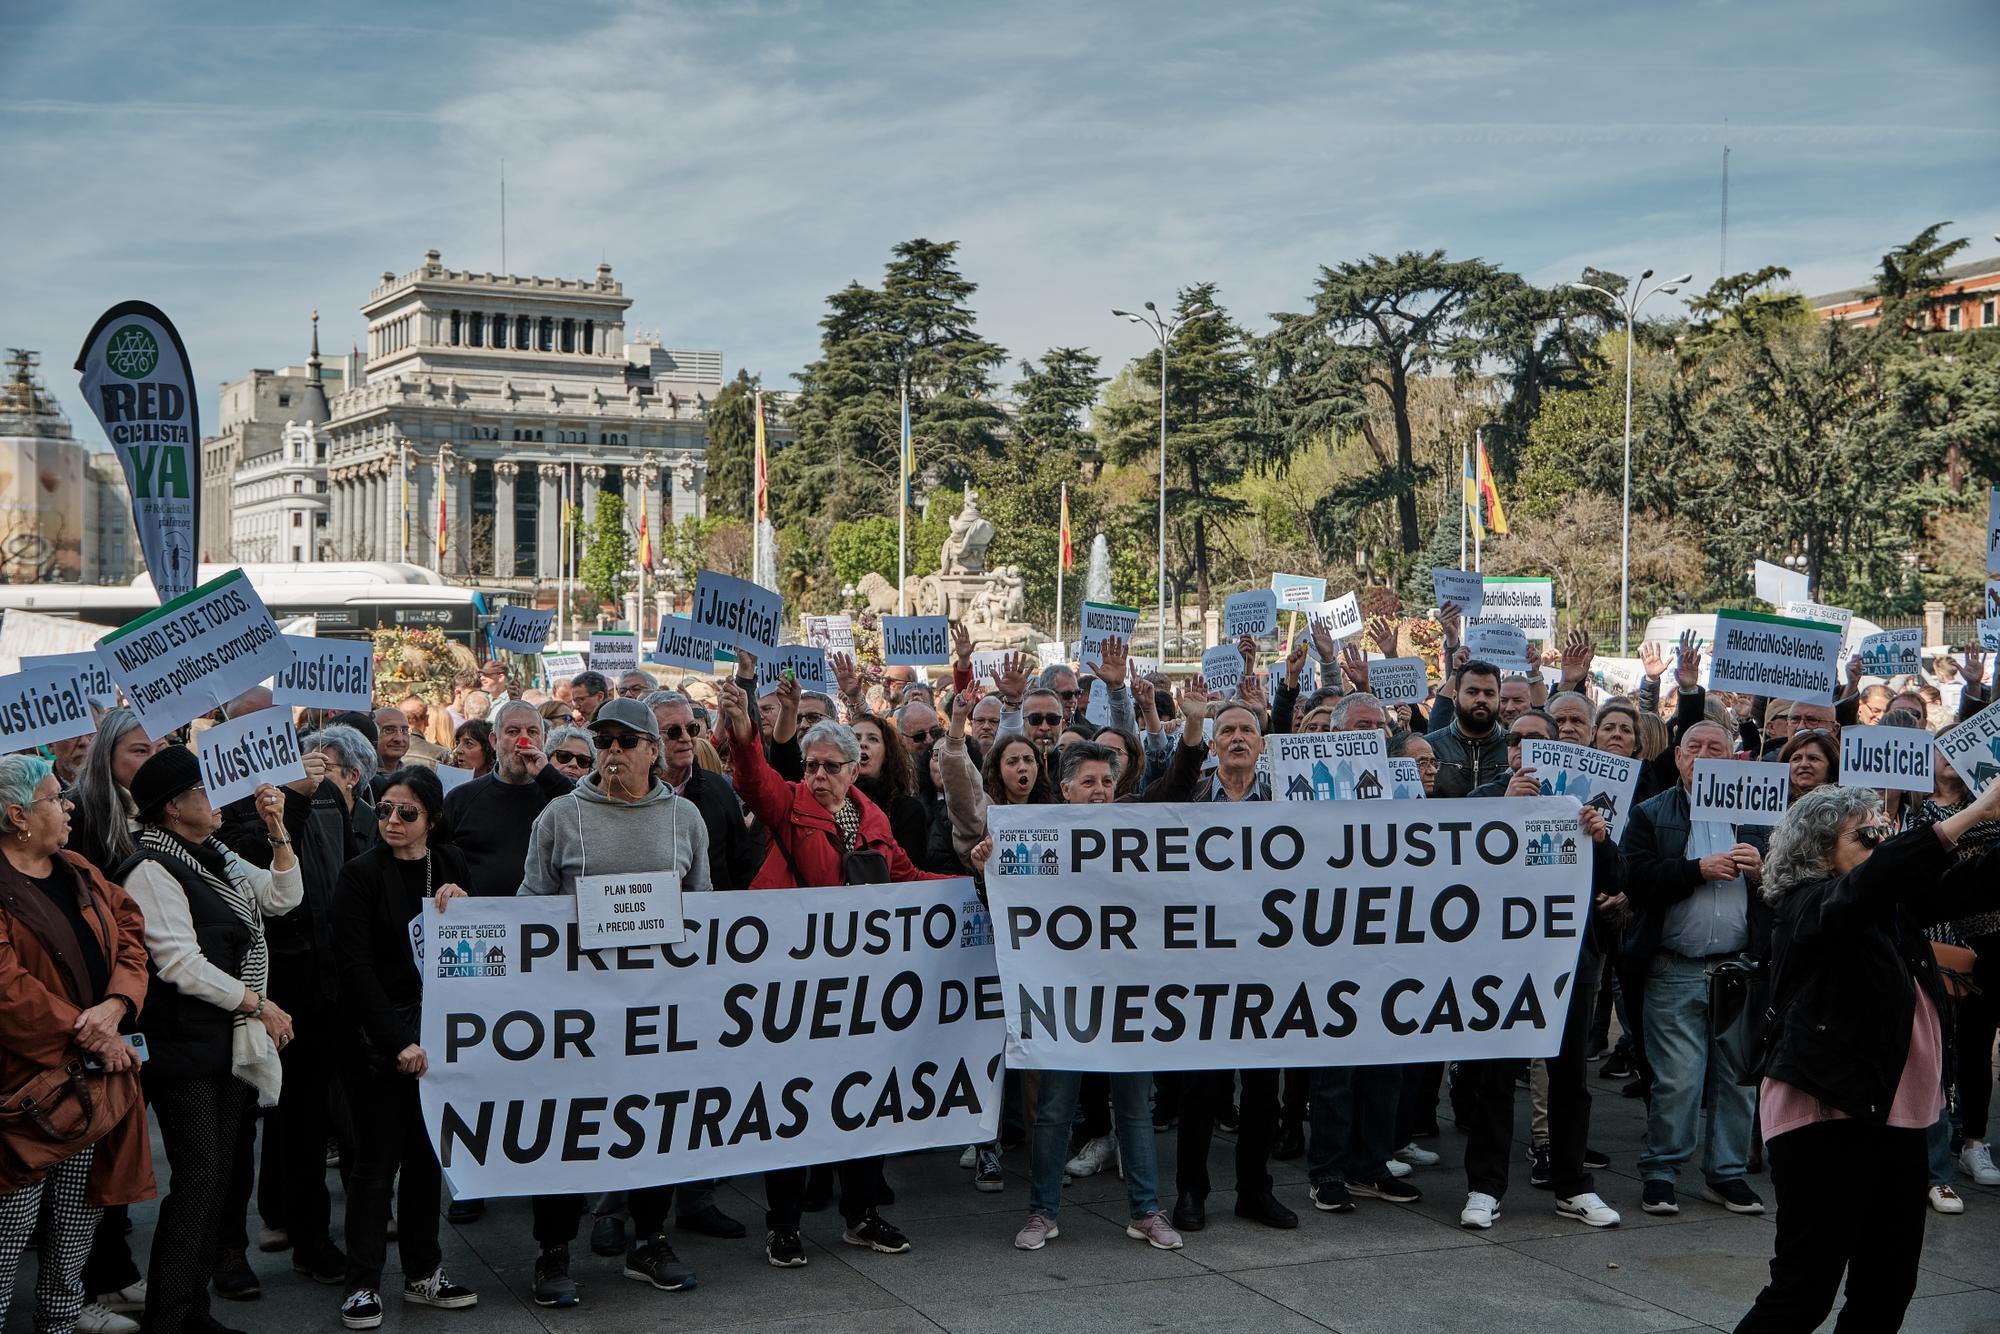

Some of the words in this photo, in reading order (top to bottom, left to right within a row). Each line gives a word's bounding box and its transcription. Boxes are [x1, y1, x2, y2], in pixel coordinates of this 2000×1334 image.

[100, 382, 185, 423] RED
[127, 445, 190, 499] YA
[697, 587, 778, 648] ¡Justicia!
[1231, 620, 1265, 636] 18000
[1808, 608, 1819, 617] EL
[1821, 610, 1848, 622] SUELO
[114, 630, 168, 673] MADRID
[162, 621, 187, 648] ES
[179, 611, 206, 638] DE
[197, 590, 251, 629] TODOS.
[659, 627, 713, 662] ¡Justicia!
[886, 627, 946, 655] ¡Justicia!
[1727, 628, 1826, 661] #MadridNoSeVende.
[1891, 633, 1918, 642] SUELO
[1480, 647, 1515, 656] VIVIENDAS
[130, 674, 173, 716] ¡Fuera
[170, 652, 220, 696] políticos
[217, 615, 277, 665] corruptos!
[1372, 664, 1415, 674] PLATAFORMA
[1715, 658, 1831, 693] #MadridVerdeHabitable.
[1890, 665, 1918, 674] 18.000
[1207, 674, 1238, 690] 18000
[1375, 684, 1417, 700] 18000
[1280, 735, 1325, 746] PLATAFORMA
[1326, 735, 1336, 743] DE
[1337, 732, 1376, 742] AFECTADOS
[1940, 712, 1990, 747] PLATAFORMA
[1944, 731, 1982, 760] POR
[1979, 719, 2000, 738] EL
[203, 721, 298, 791] ¡Justicia!
[1281, 745, 1310, 761] POR
[1313, 744, 1332, 759] EL
[1335, 741, 1379, 757] SUELO
[1532, 742, 1574, 753] PLATAFORMA
[1574, 747, 1585, 757] DE
[1586, 751, 1630, 768] AFECTADOS
[1844, 738, 1930, 777] ¡Justicia!
[1388, 760, 1398, 769] DE
[1532, 750, 1560, 767] POR
[1563, 754, 1573, 769] EL
[1577, 758, 1629, 783] SUELO
[1696, 773, 1785, 812] ¡Justicia!
[999, 834, 1017, 842] POR
[1019, 834, 1030, 842] EL
[1031, 833, 1059, 842] SUELO
[1525, 824, 1542, 832] POR
[1543, 824, 1553, 832] EL
[1554, 823, 1578, 832] SUELO
[1070, 823, 1306, 874] PRECIO
[1326, 820, 1520, 870] JUSTO
[1526, 856, 1549, 865] PLAN
[1552, 855, 1576, 864] 18.000
[999, 866, 1026, 875] PLAN
[1030, 866, 1058, 875] 18.000
[604, 884, 626, 896] PLAN
[628, 883, 653, 894] 18000
[613, 902, 646, 914] SUELOS
[962, 904, 975, 914] POR
[1006, 903, 1138, 952] POR
[1163, 903, 1237, 950] EL
[1256, 883, 1481, 949] SUELO
[1501, 893, 1577, 941] DE
[438, 930, 458, 939] POR
[460, 930, 473, 939] EL
[475, 929, 506, 938] SUELO
[597, 923, 604, 933] A
[606, 920, 635, 933] PRECIO
[638, 918, 665, 930] JUSTO
[788, 903, 957, 960] JUSTO
[438, 966, 469, 977] PLAN
[472, 966, 506, 976] 18.000
[444, 1008, 596, 1063] POR
[624, 1004, 698, 1057] EL
[718, 970, 924, 1047] SUELO
[938, 975, 1005, 1024] DE
[1018, 979, 1361, 1043] NUESTRAS
[441, 1077, 814, 1168] NUESTRAS
